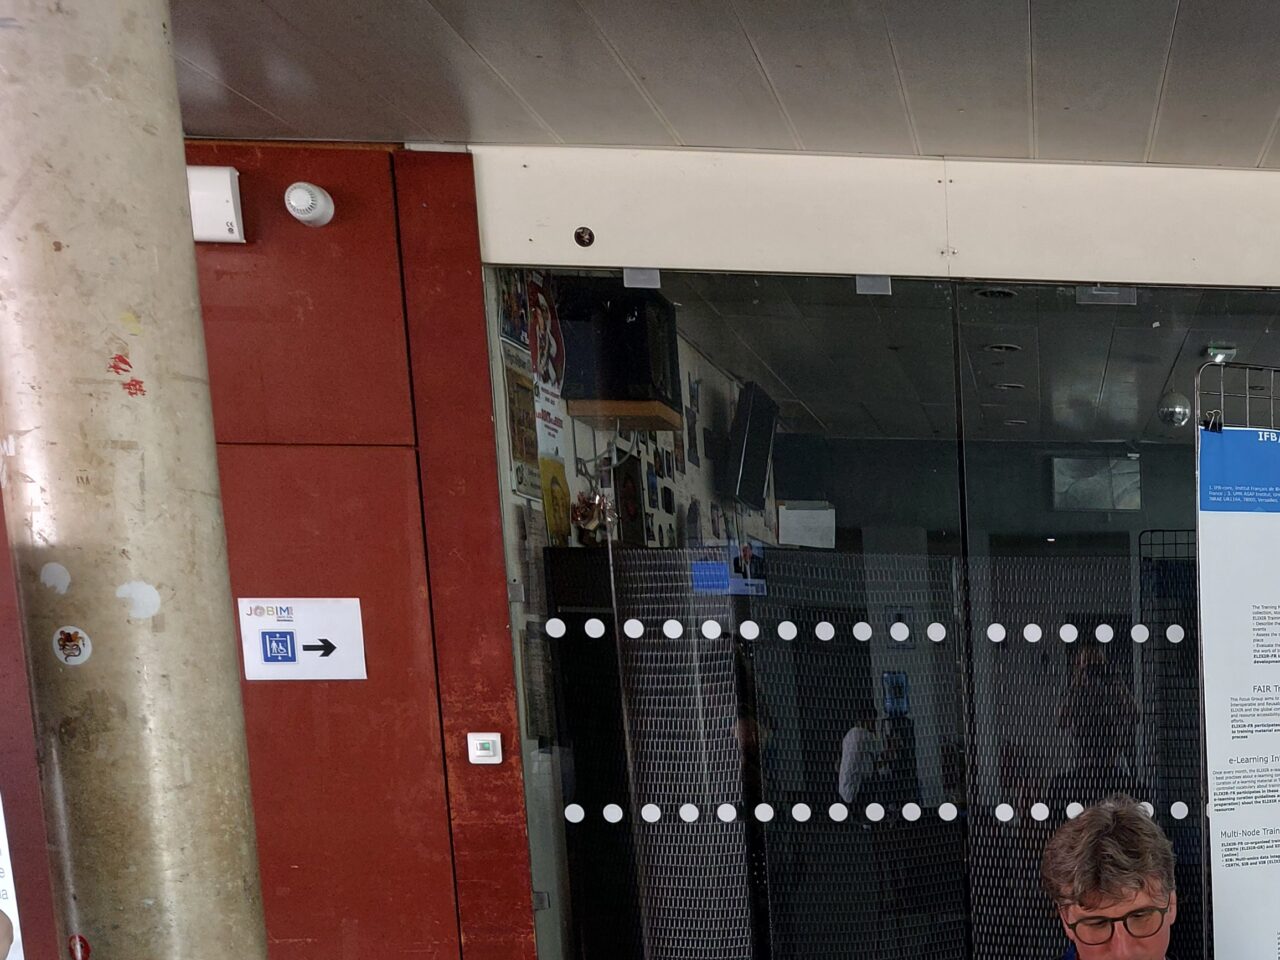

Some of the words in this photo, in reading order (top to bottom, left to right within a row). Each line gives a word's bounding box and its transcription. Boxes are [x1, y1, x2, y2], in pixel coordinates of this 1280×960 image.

[246, 605, 289, 617] JOBIM
[1253, 685, 1271, 693] FAIR
[1229, 755, 1268, 764] e-Learning
[1220, 829, 1260, 839] Multi-Node
